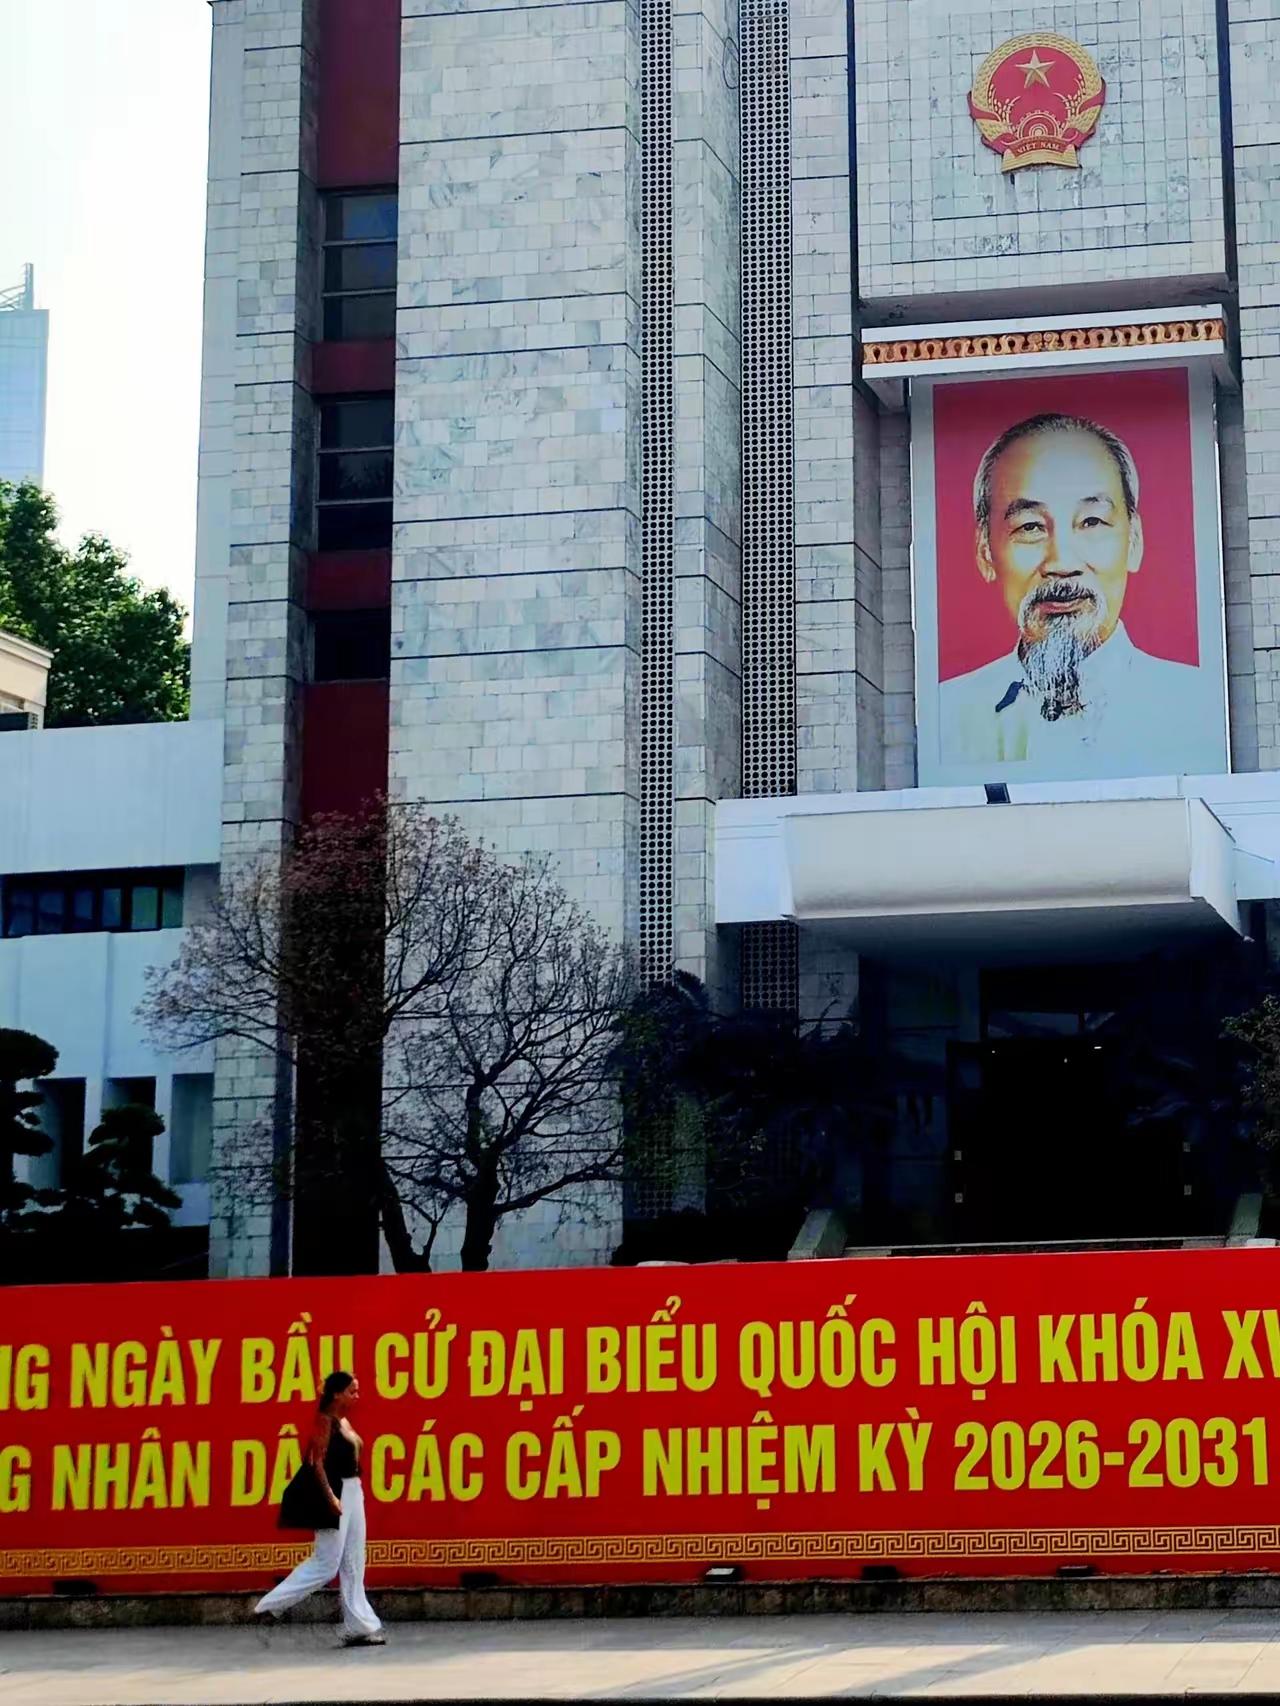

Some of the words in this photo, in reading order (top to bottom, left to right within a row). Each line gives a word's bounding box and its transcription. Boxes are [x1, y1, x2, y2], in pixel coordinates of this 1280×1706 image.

[1040, 142, 1059, 150] NAM
[70, 1325, 222, 1409] NGÀY
[241, 1311, 355, 1403] BẦU
[375, 1308, 457, 1400] CỬ
[467, 1328, 564, 1412] ĐẠI
[586, 1295, 717, 1394] BIỂU
[739, 1293, 897, 1398] QUỐC
[918, 1300, 1017, 1401] HỘI
[1038, 1296, 1204, 1383] KHÓA
[52, 1427, 211, 1511] NHÂN
[230, 1422, 304, 1507] DÂ
[371, 1419, 484, 1503] CÁC
[505, 1404, 621, 1501] CẤP
[642, 1410, 836, 1510] NHIỆM
[858, 1407, 933, 1492] KỲ
[954, 1416, 1269, 1491] 2026-2031
